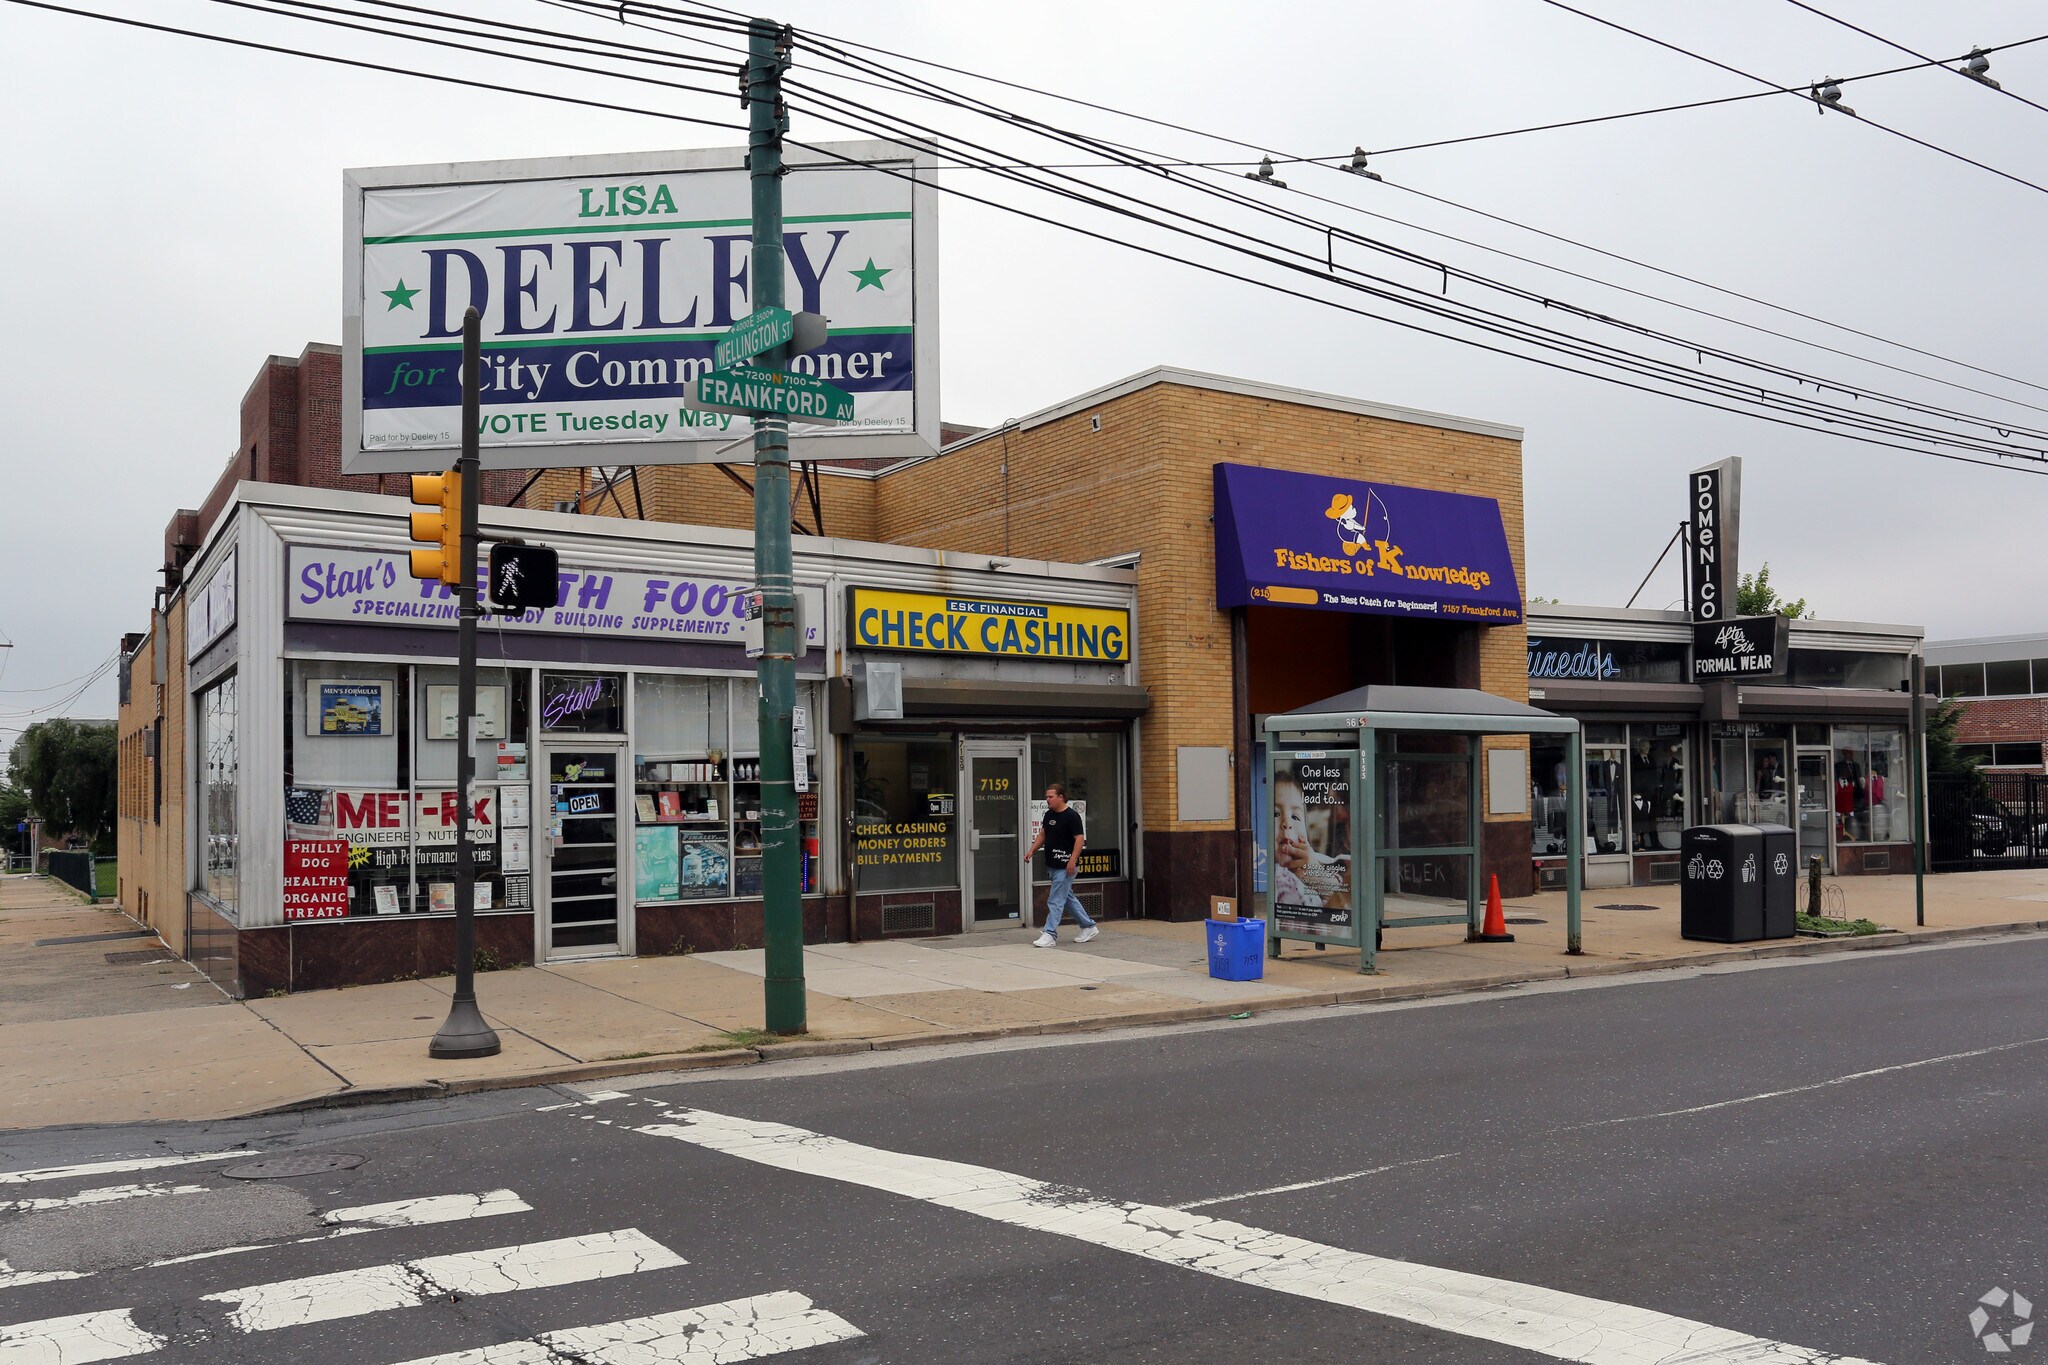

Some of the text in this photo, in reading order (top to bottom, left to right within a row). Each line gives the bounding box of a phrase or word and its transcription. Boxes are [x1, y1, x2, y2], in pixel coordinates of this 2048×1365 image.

[578, 184, 678, 218] LISA
[420, 229, 850, 340] DEELEY
[735, 318, 750, 333] 4000
[756, 311, 771, 323] 3500
[717, 319, 791, 367] WELLINGTON ST
[384, 362, 445, 394] for
[458, 353, 551, 400] City
[745, 371, 806, 387] 7200 N 7100
[701, 377, 853, 419] FRANKFORD AV
[479, 408, 733, 435] VOTE Tuesday May
[852, 418, 862, 428] by
[864, 416, 893, 427] Deeley
[895, 416, 906, 426] 15
[369, 431, 450, 443] Paid for by Deeley 15
[1273, 539, 1491, 591] Fishers of Knowledge
[300, 558, 396, 605] Stan's
[950, 602, 1044, 618] ESK FINANCIAL
[1323, 593, 1339, 604] The
[1340, 595, 1358, 606] Best
[1359, 596, 1382, 607] Catch
[1383, 598, 1397, 609] for
[1397, 600, 1438, 613] Beginners!
[1442, 604, 1460, 614] 7157
[1462, 605, 1501, 617] Frankford
[1503, 608, 1520, 619] Ave.
[554, 611, 623, 630] BUILDING
[631, 615, 730, 635] SUPPLEMENTS
[859, 608, 1124, 660] CHECK CASHING
[1715, 626, 1746, 650] After
[1731, 638, 1756, 655] Six
[1695, 653, 1772, 674] FORMAL WEAR
[323, 687, 378, 696] MEN'S FORMULAS
[1301, 765, 1341, 778] One less
[980, 778, 1009, 791] 7159
[1301, 781, 1349, 795] worry can
[571, 795, 599, 812] OPEN
[1301, 791, 1345, 805] lead to...
[856, 822, 947, 835] CHECK CASHING
[292, 843, 343, 854] PHILLY
[857, 837, 947, 850] MONEY ORDERS
[301, 857, 330, 868] DOG
[376, 849, 397, 869] High
[857, 852, 942, 865] BILL PAYMENTS
[1077, 864, 1110, 873] UNION
[284, 876, 347, 888] HEALTHY
[284, 892, 346, 904] ORGANIC
[286, 906, 343, 919] TREATS
